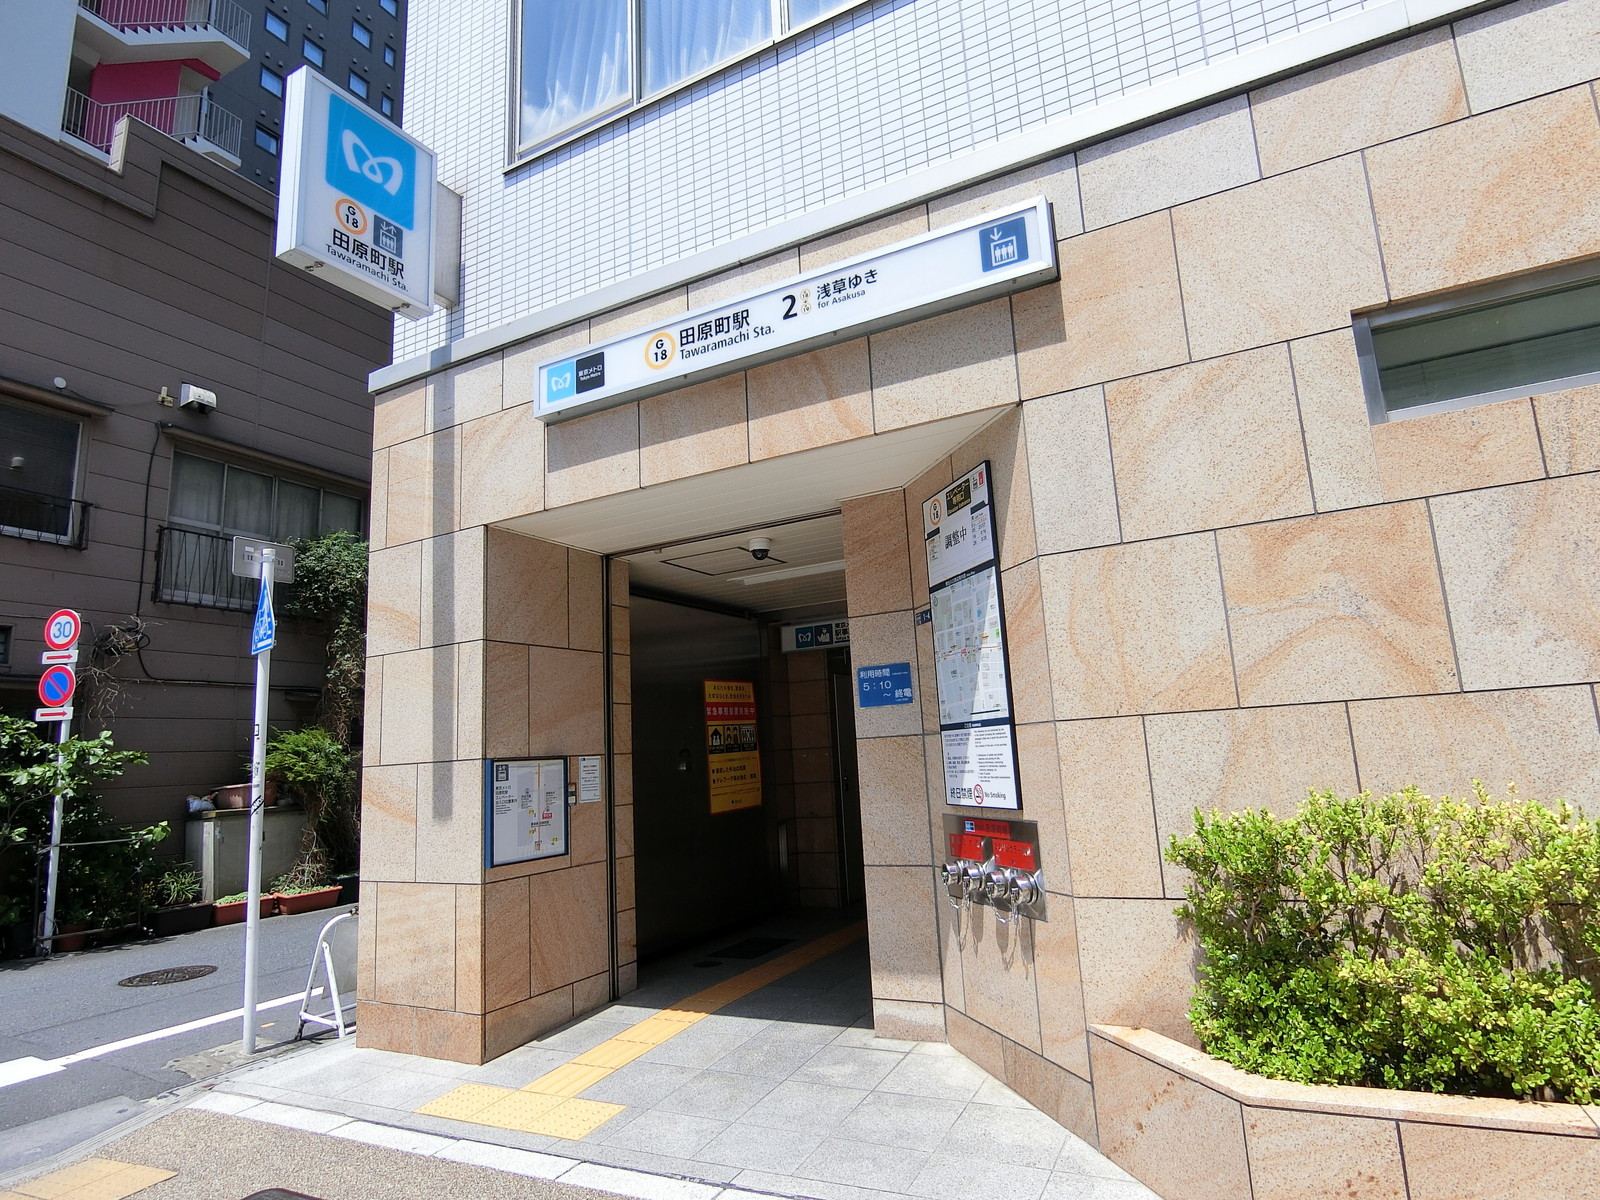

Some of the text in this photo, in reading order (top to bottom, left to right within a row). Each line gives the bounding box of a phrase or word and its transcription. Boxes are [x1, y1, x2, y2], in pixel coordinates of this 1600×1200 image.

[347, 205, 357, 216] G
[345, 213, 359, 229] 18
[333, 228, 405, 280] 田原町駅
[325, 243, 409, 292] Tawaramachi Sta.
[816, 269, 878, 300] 浅草ゆき
[817, 289, 866, 309] for Asakusa
[782, 294, 798, 321] 2
[679, 308, 750, 348] 田原町駅
[655, 339, 665, 350] G
[680, 325, 775, 360] Tawaramachi Sta.
[653, 349, 668, 362] 18
[578, 364, 603, 377] 東京メトロ
[933, 503, 938, 511] G
[933, 510, 939, 520] 18
[945, 526, 967, 550] 調整中
[53, 621, 72, 639] 30
[860, 668, 890, 679] 利用時間
[895, 687, 912, 698] 終電
[950, 787, 973, 799] 終日禁煙
[990, 792, 1006, 800] Smoking
